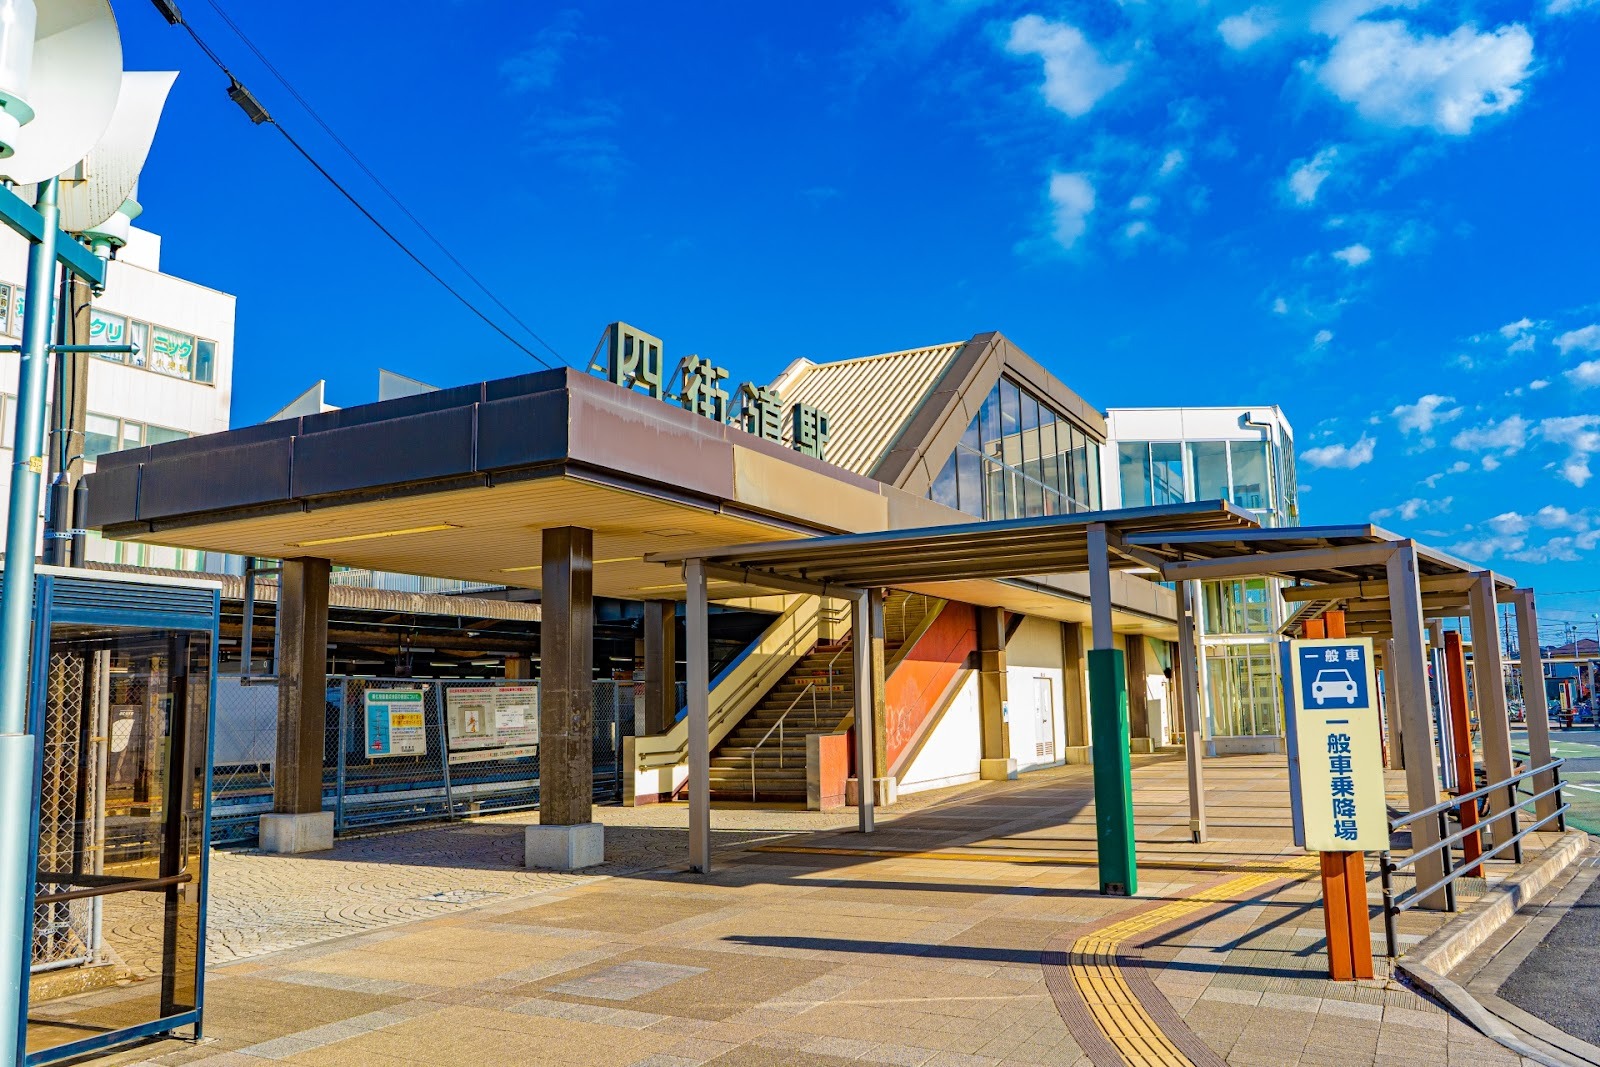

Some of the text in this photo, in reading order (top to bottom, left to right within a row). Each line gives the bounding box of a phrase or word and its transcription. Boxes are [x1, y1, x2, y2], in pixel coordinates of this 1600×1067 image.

[608, 321, 830, 461] 四街道駅
[1304, 648, 1360, 662] 一般車
[1326, 719, 1358, 841] 一般車乗降場
